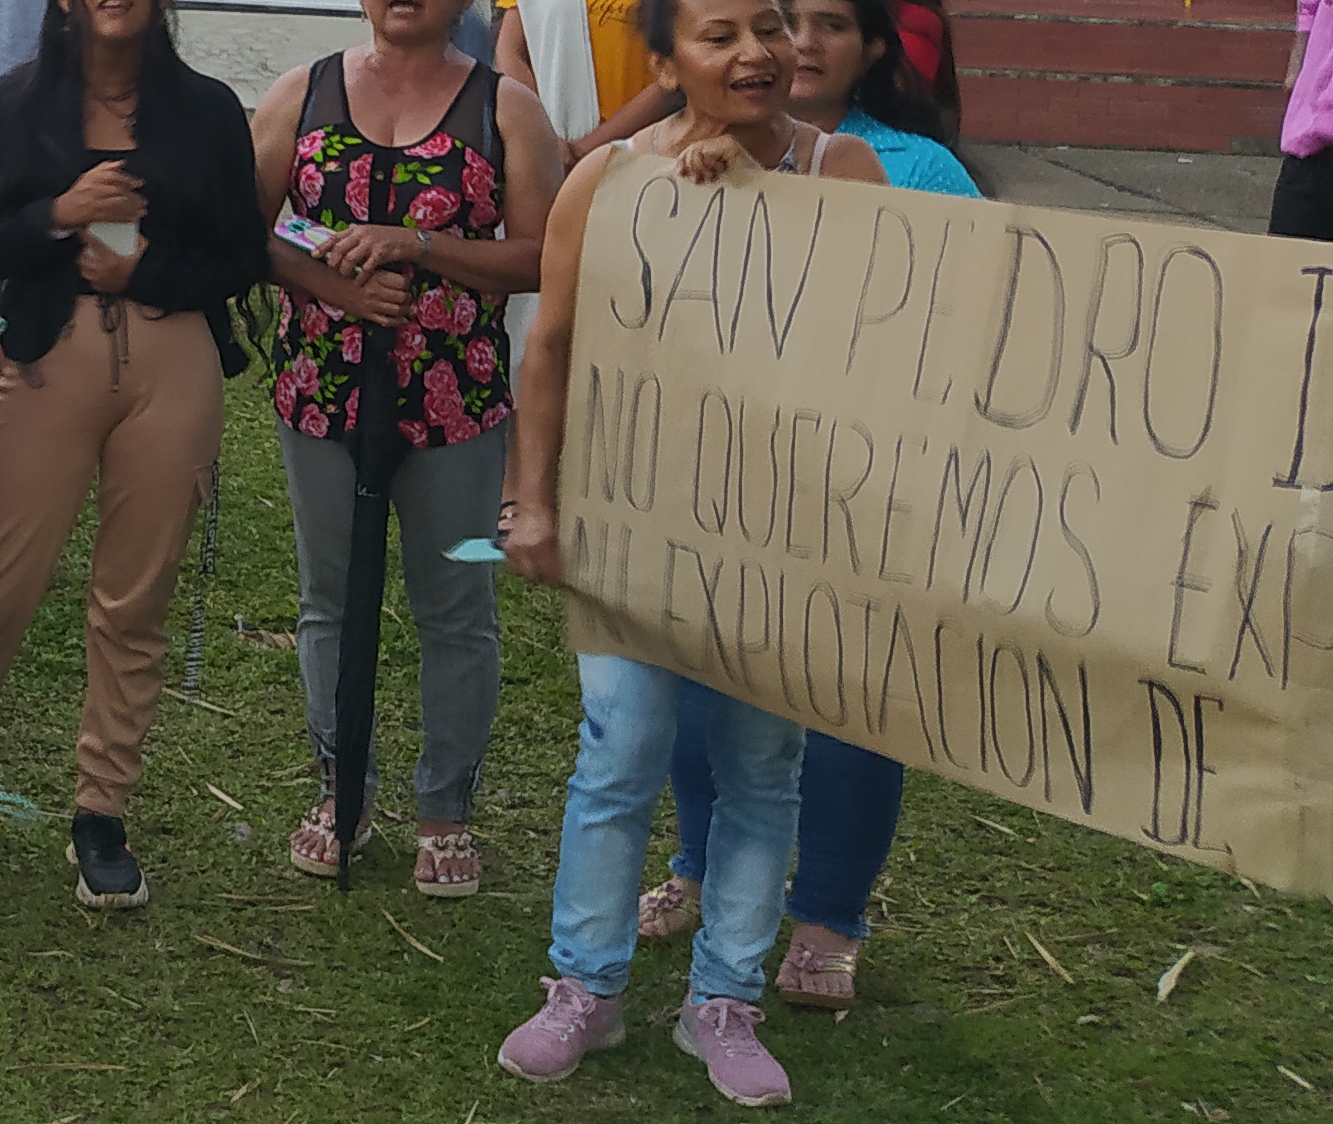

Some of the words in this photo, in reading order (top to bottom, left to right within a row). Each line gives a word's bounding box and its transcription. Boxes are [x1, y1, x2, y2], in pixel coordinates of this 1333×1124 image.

[610, 176, 825, 360] SAN
[845, 204, 1223, 460] PEDRO
[579, 363, 664, 513] NO
[692, 386, 1102, 639] QUEREMOS
[664, 537, 1094, 815] EXPLOTACION
[1137, 678, 1233, 856] DE
